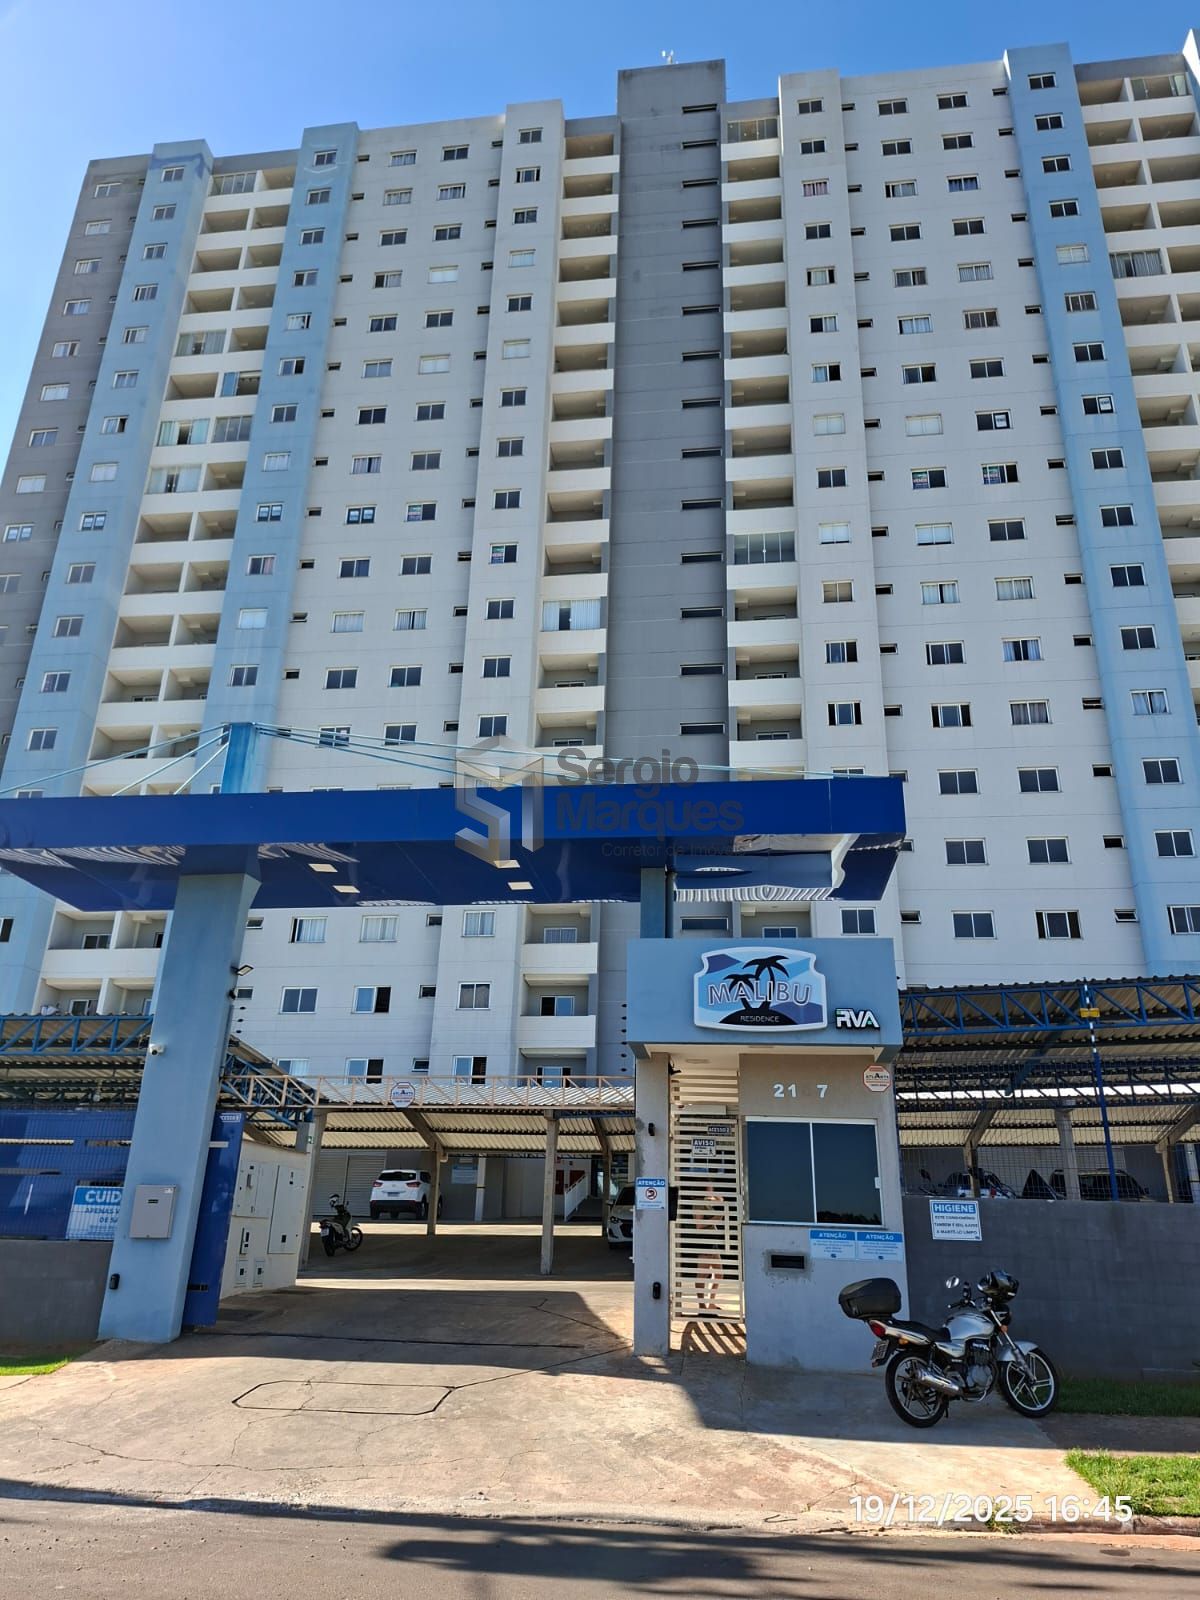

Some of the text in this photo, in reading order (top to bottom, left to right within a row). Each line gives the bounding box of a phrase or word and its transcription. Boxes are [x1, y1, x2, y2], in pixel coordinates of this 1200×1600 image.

[708, 980, 811, 1006] MALIBU
[740, 1015, 780, 1023] RESIDENCE
[835, 1008, 880, 1029] RVA
[934, 1204, 974, 1213] HIGIENE
